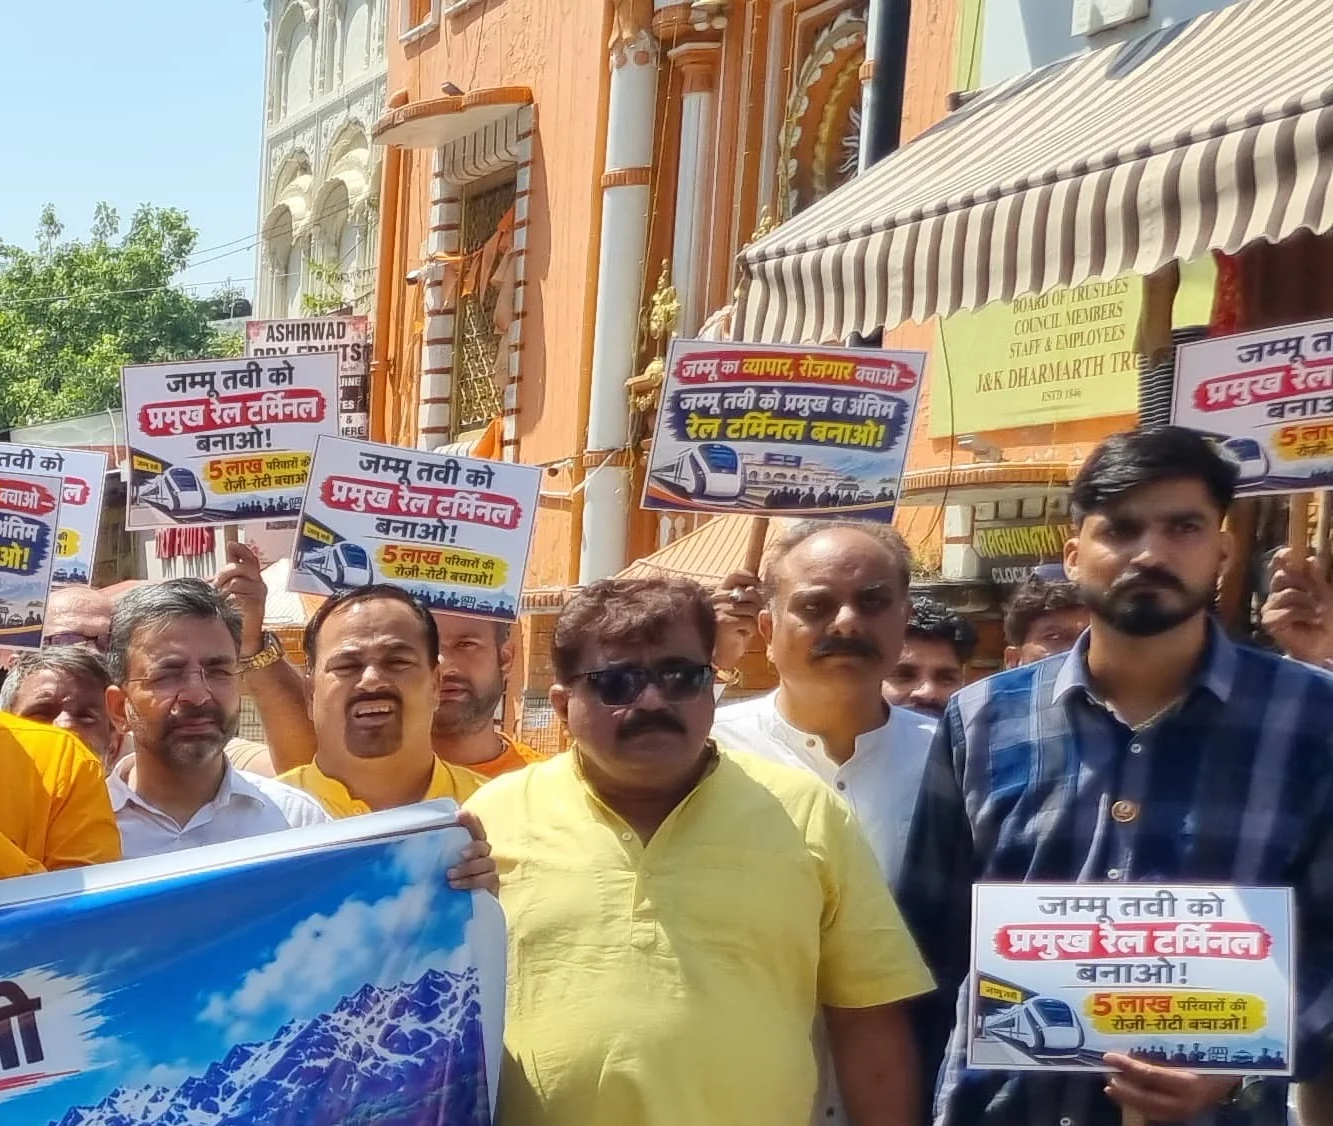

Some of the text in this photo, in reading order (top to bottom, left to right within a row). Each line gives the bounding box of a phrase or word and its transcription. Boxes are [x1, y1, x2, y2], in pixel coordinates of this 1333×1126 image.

[266, 321, 347, 343] ASHIRWAD
[1014, 301, 1124, 336] COUNCIL MEMBERS
[1009, 338, 1042, 359] STAFF
[1056, 323, 1126, 350] EMPLOYEES
[975, 370, 1004, 393] J&K
[1008, 354, 1105, 389] DHARMARTH
[1037, 889, 1226, 924] जम्मू तवी को
[1006, 920, 1262, 960] प्रमुख रेल टर्मिनल
[1076, 957, 1188, 985] बनाओ!
[1092, 993, 1247, 1017] 5 लाख परिवारों की
[1188, 1014, 1248, 1031] बचाओ!
